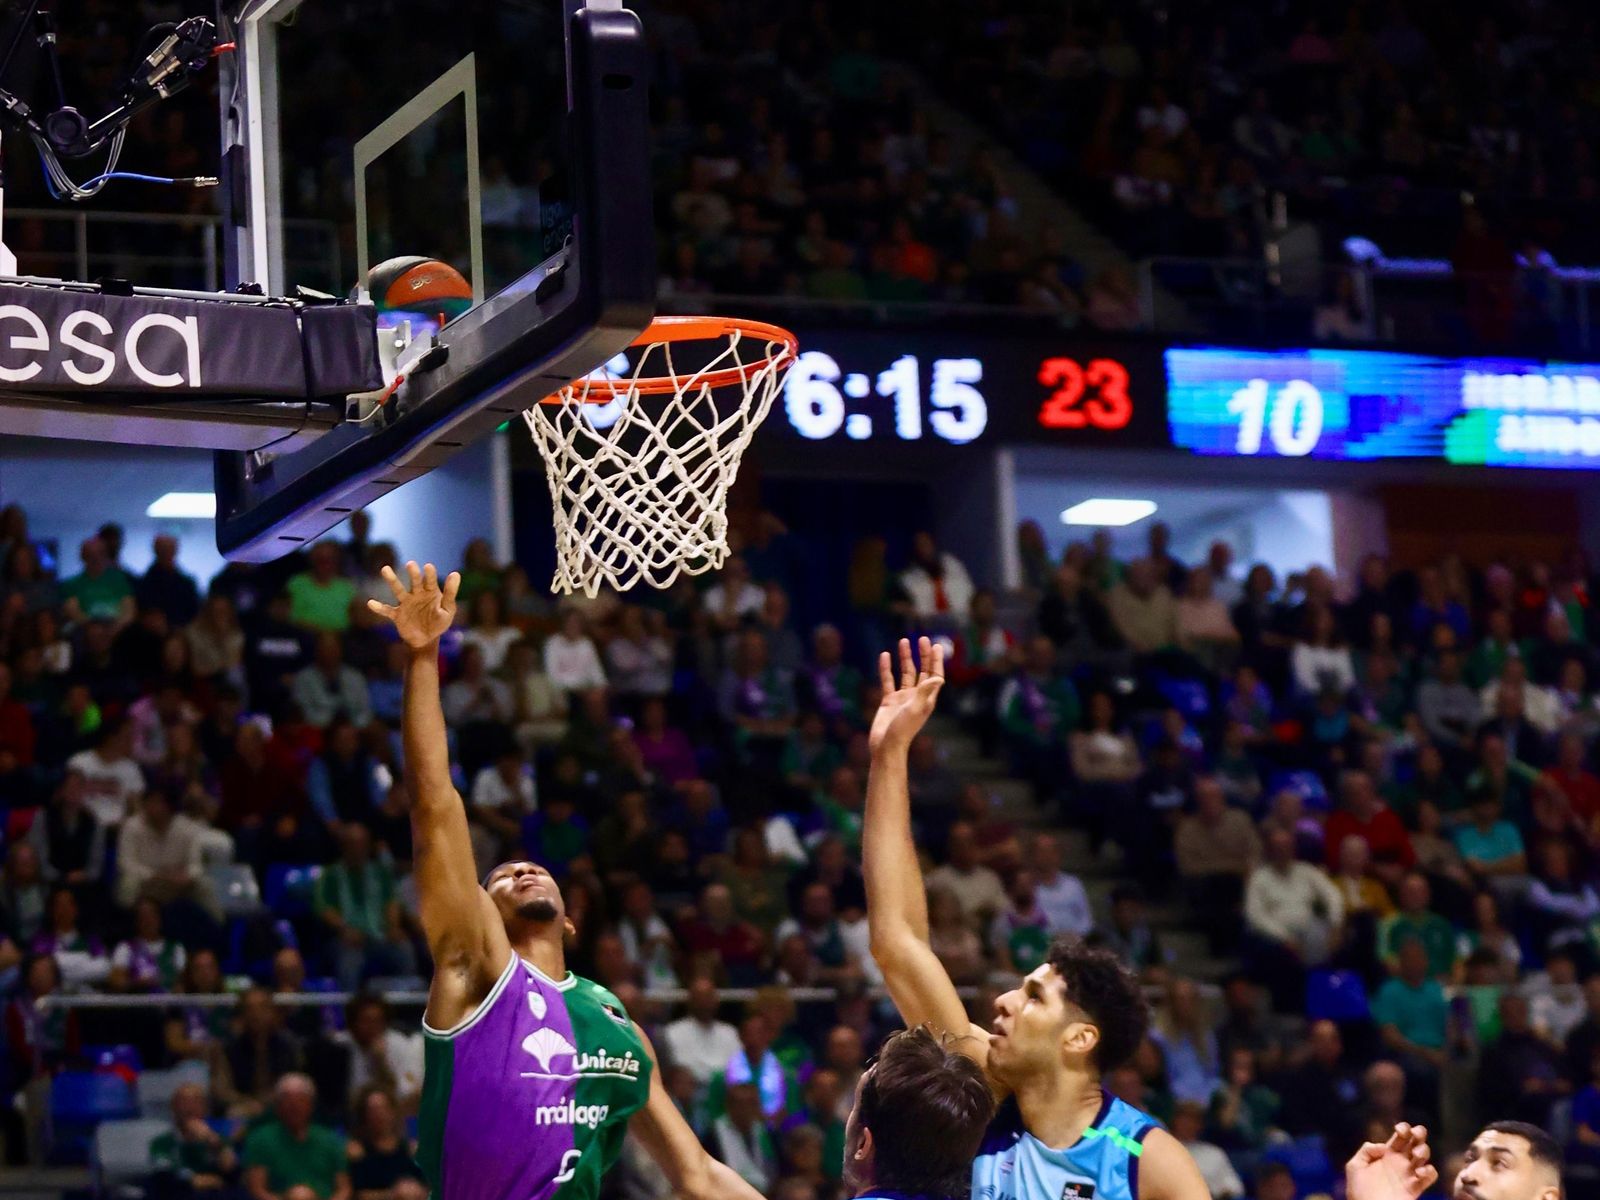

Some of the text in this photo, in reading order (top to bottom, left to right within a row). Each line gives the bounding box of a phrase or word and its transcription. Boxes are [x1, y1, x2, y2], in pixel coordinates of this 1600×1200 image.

[0, 304, 201, 388] esa
[784, 351, 987, 444] 6:15
[1038, 357, 1133, 430] 23
[1226, 378, 1324, 457] 10
[572, 1048, 640, 1074] Unicaja
[536, 1096, 609, 1130] málaga
